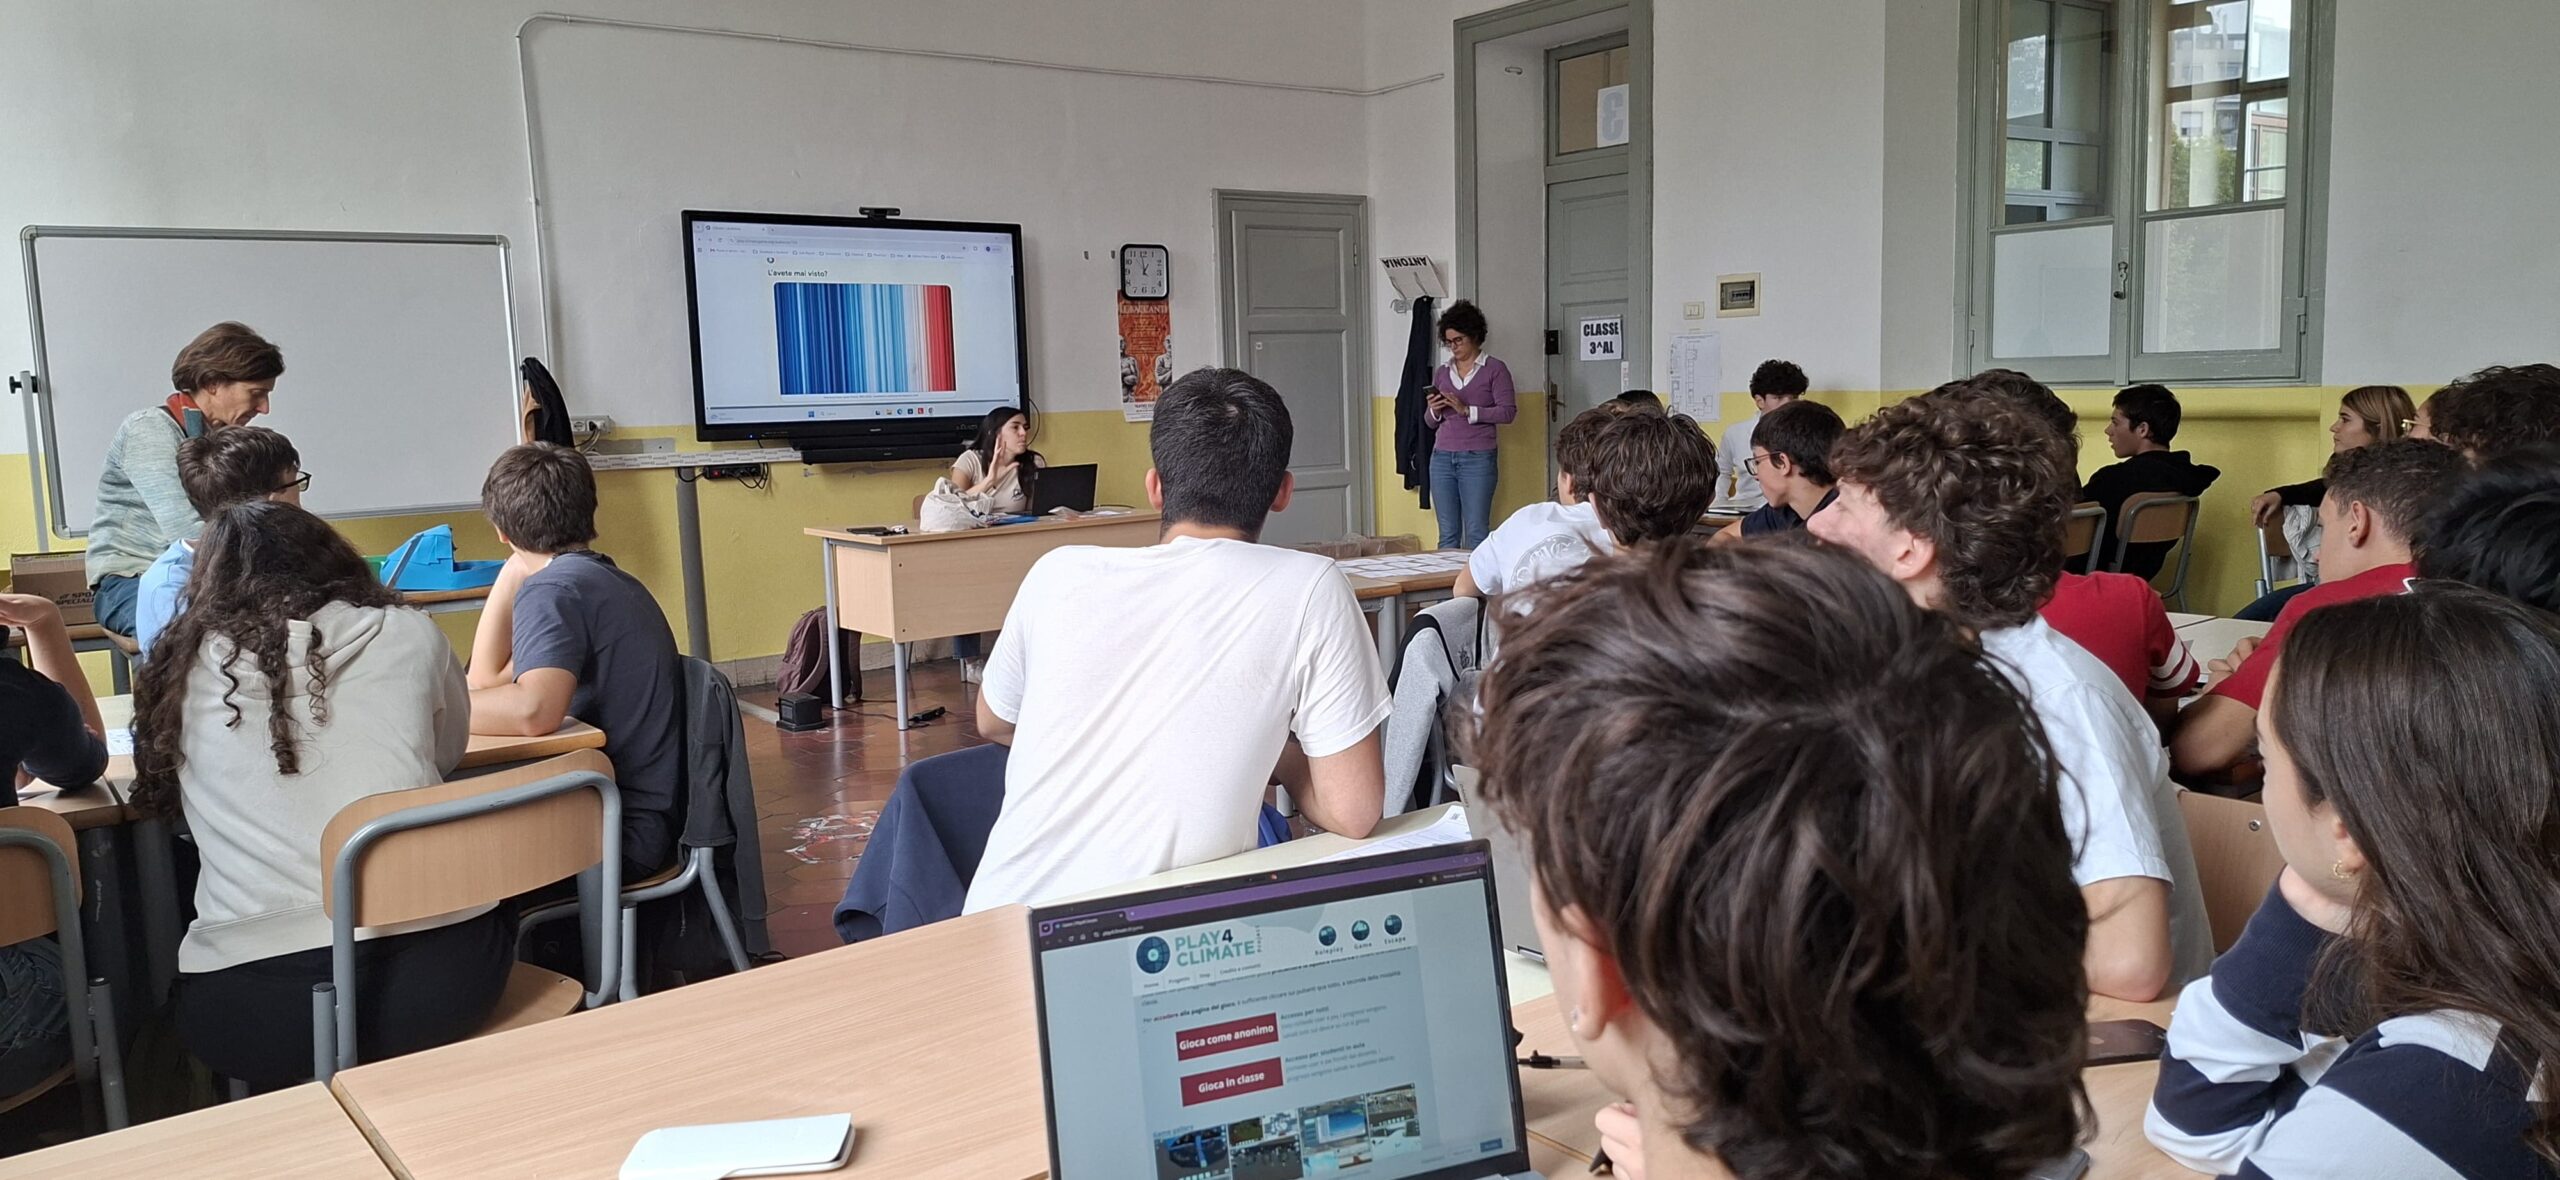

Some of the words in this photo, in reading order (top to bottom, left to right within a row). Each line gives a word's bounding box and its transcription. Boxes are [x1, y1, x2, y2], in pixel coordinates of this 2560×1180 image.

[1381, 257, 1427, 268] ANTONIA
[767, 269, 793, 277] L'avete
[1583, 322, 1619, 337] CLASSE
[1589, 341, 1614, 355] 3^AL
[1384, 936, 1406, 945] Escape
[1176, 940, 1256, 967] CLIMATE
[1179, 1036, 1206, 1051] Gioca
[1207, 1033, 1232, 1045] come
[1234, 1024, 1274, 1040] anonimo
[1198, 1080, 1225, 1093] Gioca
[1226, 1077, 1236, 1087] in
[1237, 1071, 1265, 1085] classe
